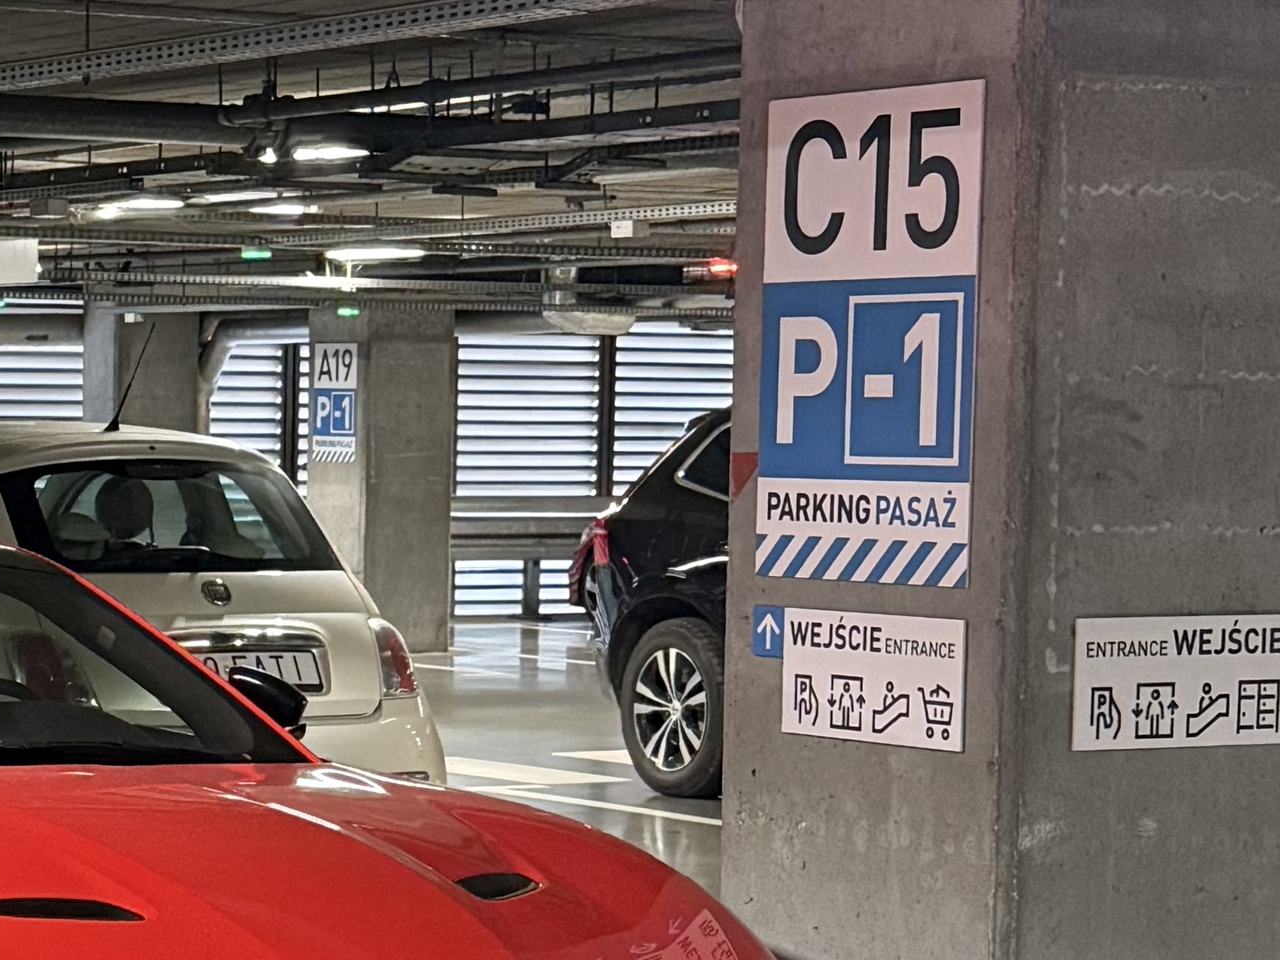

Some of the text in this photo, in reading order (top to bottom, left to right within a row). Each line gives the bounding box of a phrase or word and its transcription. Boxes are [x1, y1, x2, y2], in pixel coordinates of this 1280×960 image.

[783, 107, 962, 255] C15
[317, 348, 353, 382] A19
[790, 615, 956, 659] WEJŚCIE ENTRANCE
[1086, 619, 1280, 659] ENTRANCE WEJŚCIE
